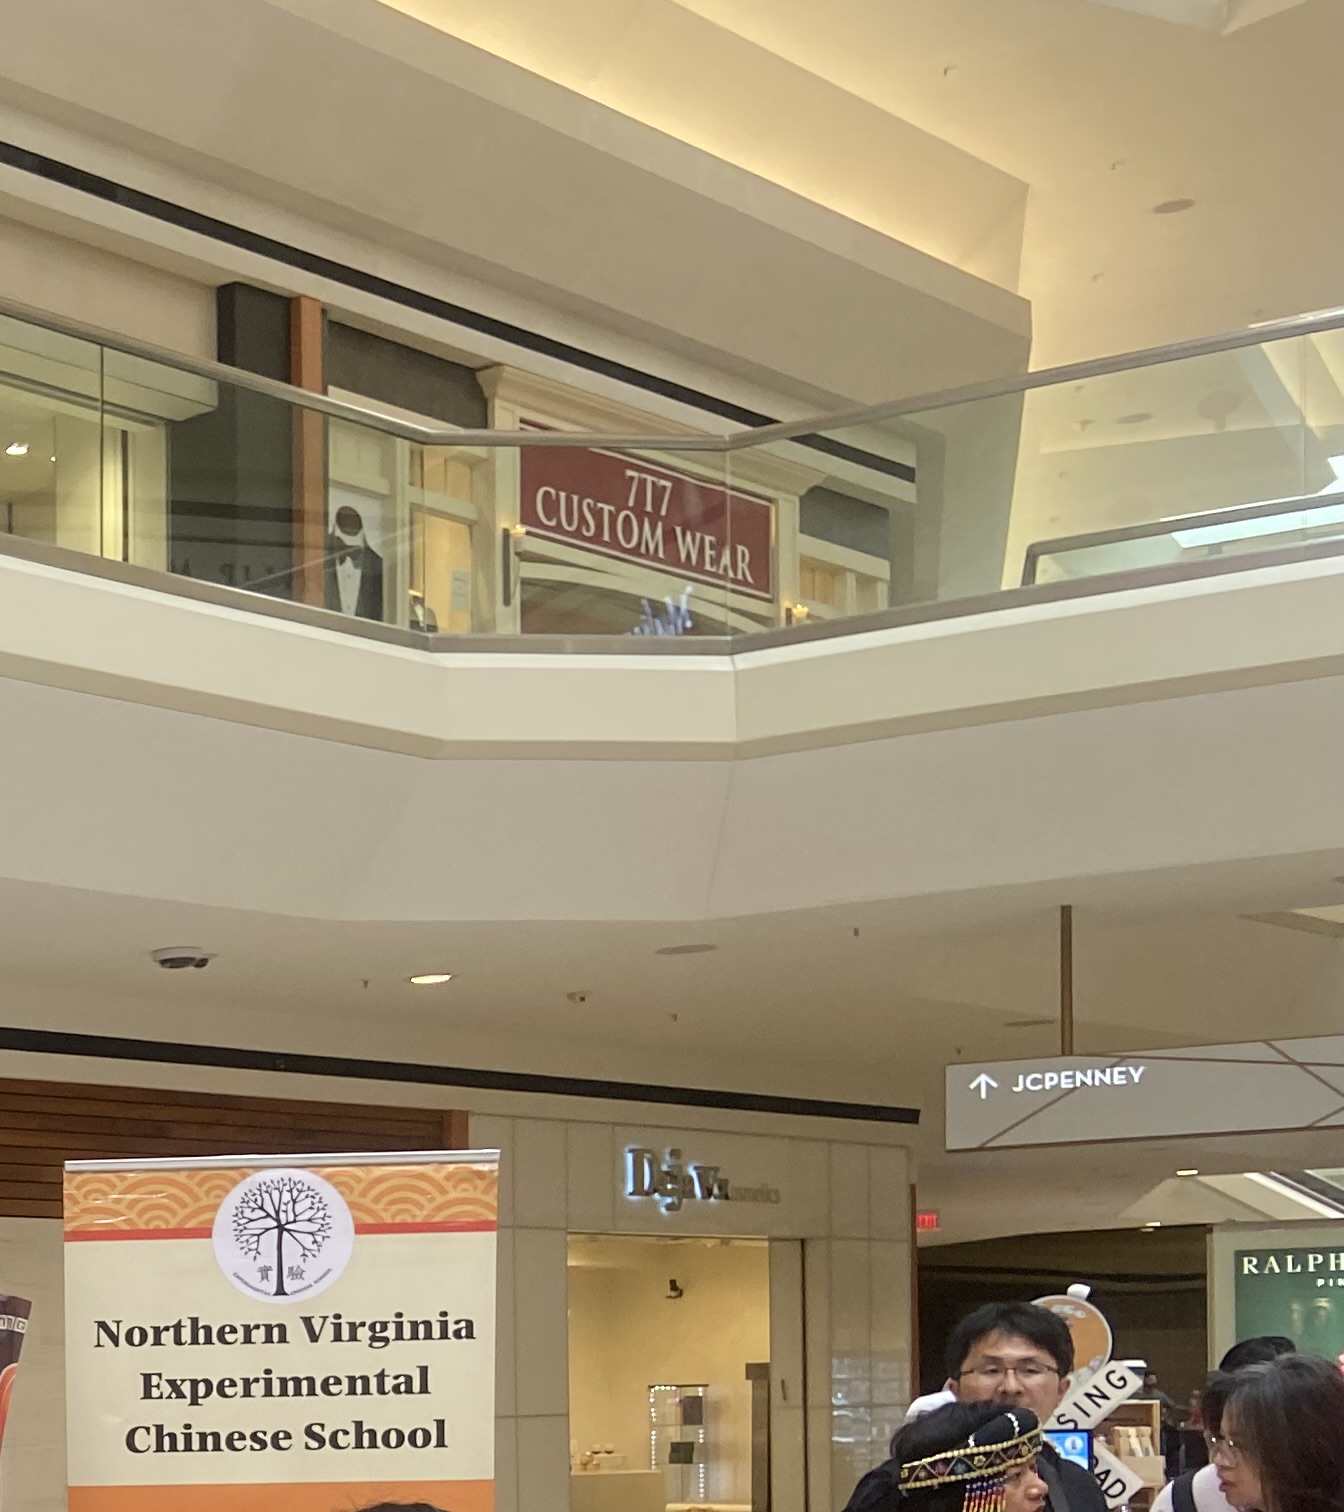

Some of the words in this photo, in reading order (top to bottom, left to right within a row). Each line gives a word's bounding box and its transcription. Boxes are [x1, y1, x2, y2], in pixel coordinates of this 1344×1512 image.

[625, 469, 673, 517] 7T7
[535, 486, 665, 559] CUSTOM
[674, 525, 754, 584] WEAR
[1012, 1066, 1146, 1093] JCPENNEY
[1243, 1252, 1344, 1275] RALPH
[94, 1313, 287, 1349] Northern
[299, 1310, 476, 1348] Virginia
[139, 1365, 430, 1407] Experimental
[1056, 1369, 1128, 1430] SING
[124, 1422, 293, 1455] Chinese
[303, 1419, 448, 1452] School
